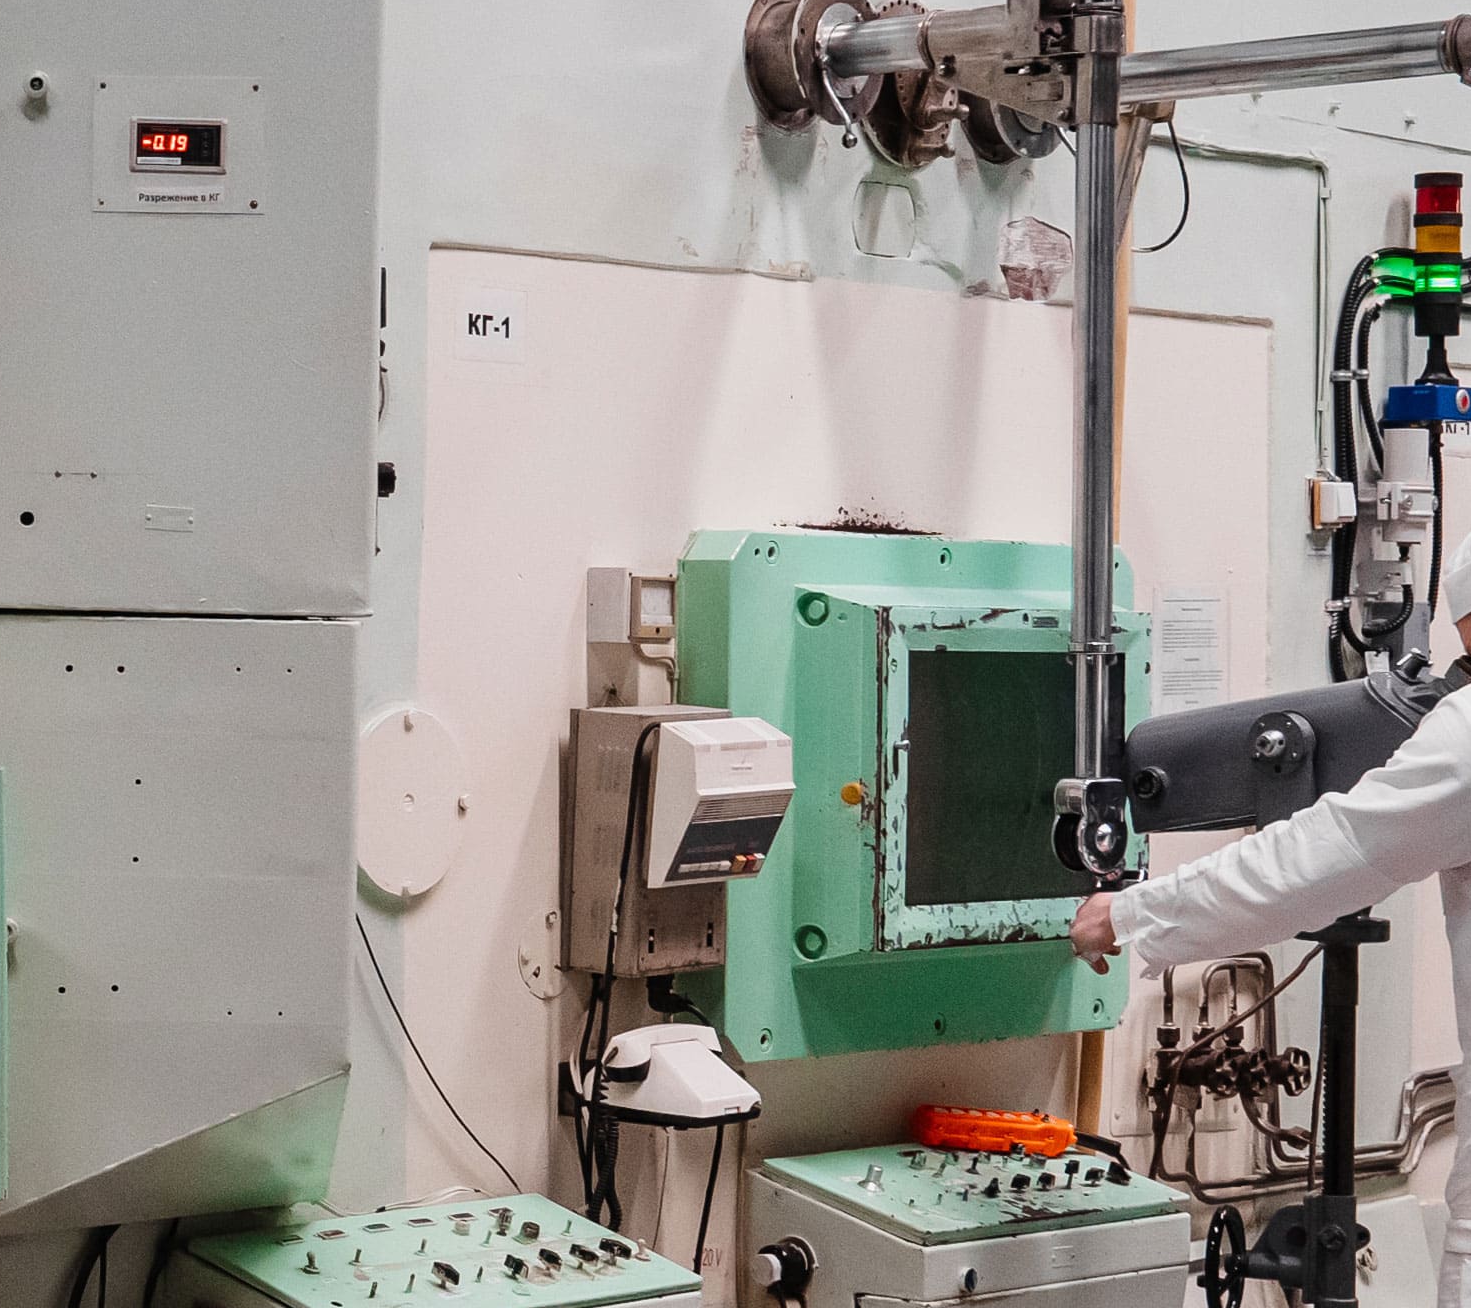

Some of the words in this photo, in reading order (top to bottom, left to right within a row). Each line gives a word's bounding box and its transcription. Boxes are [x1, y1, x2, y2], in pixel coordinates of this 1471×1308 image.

[138, 192, 199, 203] Разрежение
[208, 193, 220, 202] КГ
[468, 313, 510, 339] КГ-1
[714, 1248, 722, 1268] V
